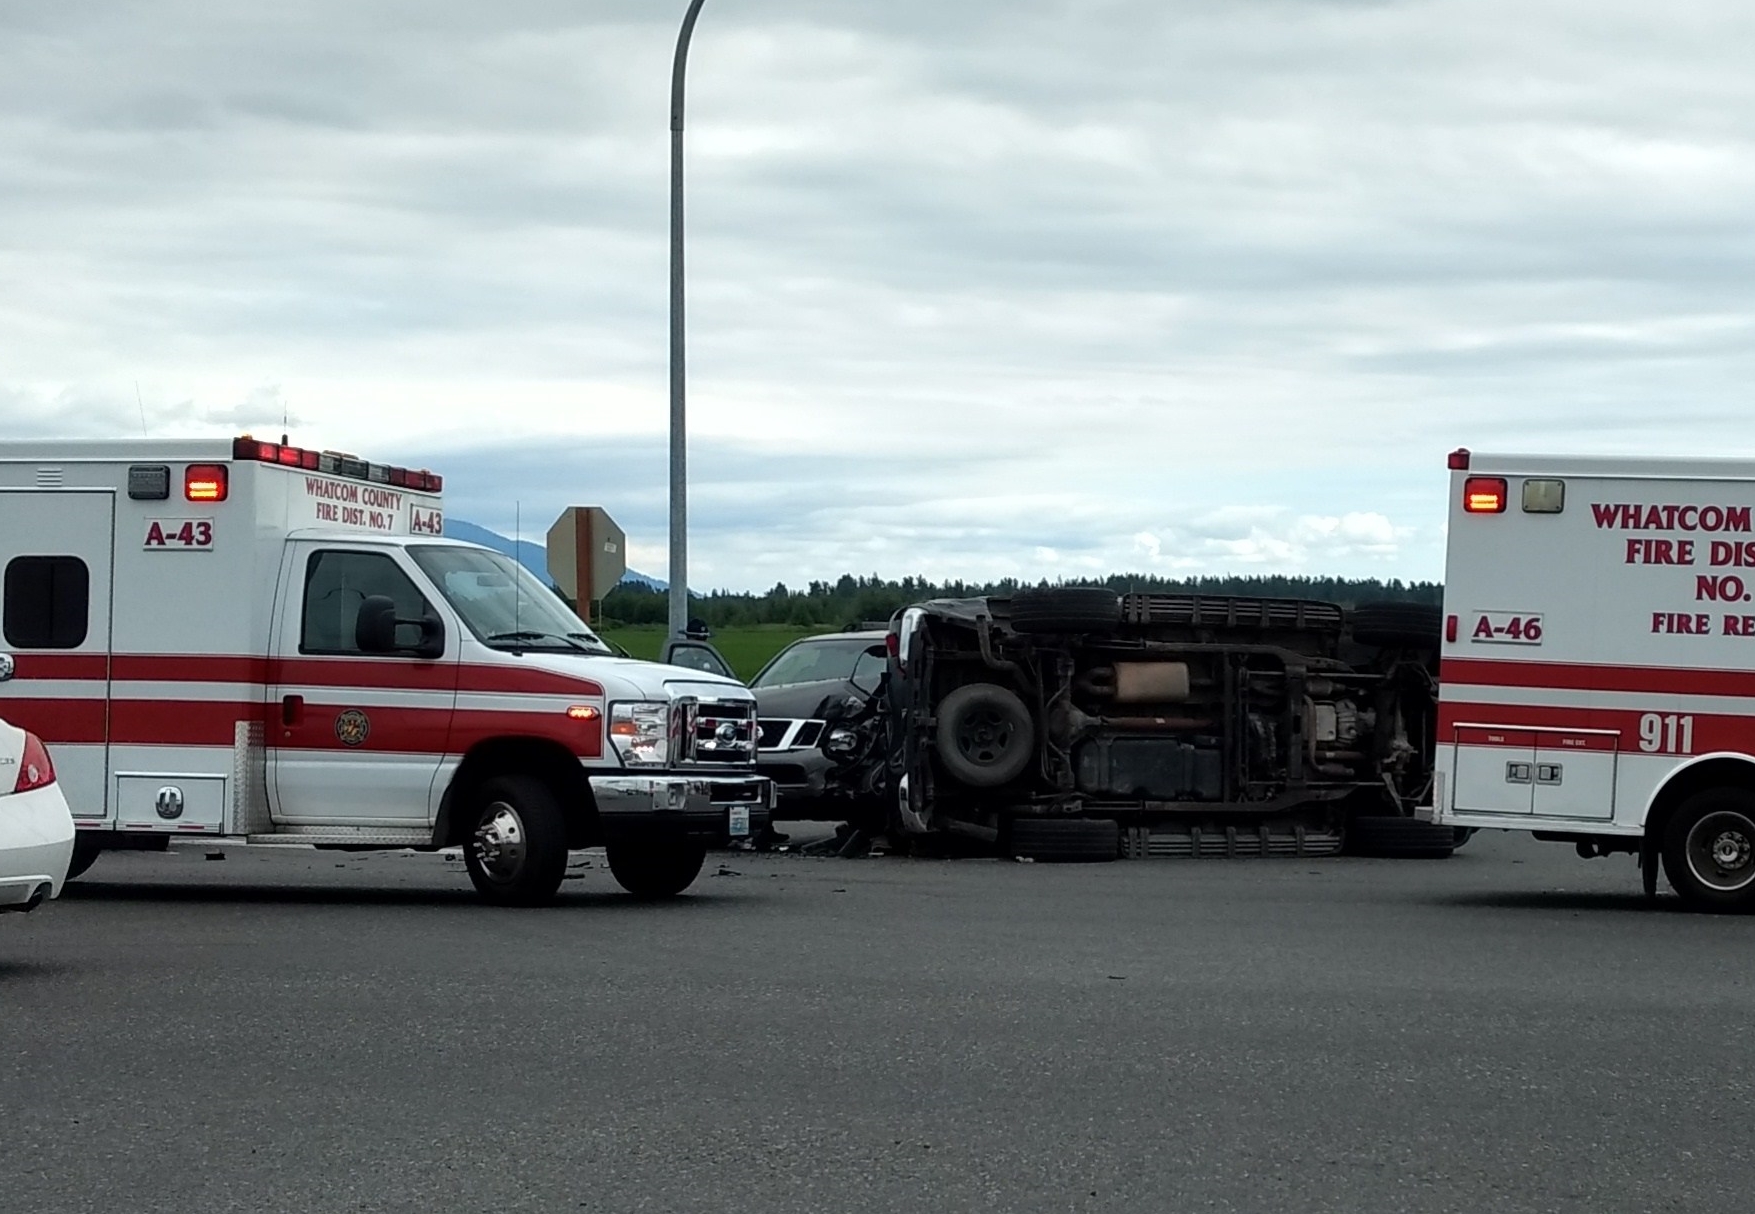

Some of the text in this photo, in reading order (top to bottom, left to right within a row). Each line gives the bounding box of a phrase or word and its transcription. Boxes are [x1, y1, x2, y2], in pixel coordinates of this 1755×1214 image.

[305, 477, 402, 511] WHATCOM COUNTY
[316, 502, 394, 531] FIRE DIST. NO. 7
[413, 509, 442, 535] A-43
[1591, 503, 1752, 532] WHATCOM
[144, 521, 212, 546] A-43
[1625, 538, 1695, 565] FIRE
[1696, 575, 1751, 602] NO.
[1472, 615, 1542, 641] A-46
[1651, 612, 1755, 636] FIRE RE
[1639, 713, 1693, 753] 911
